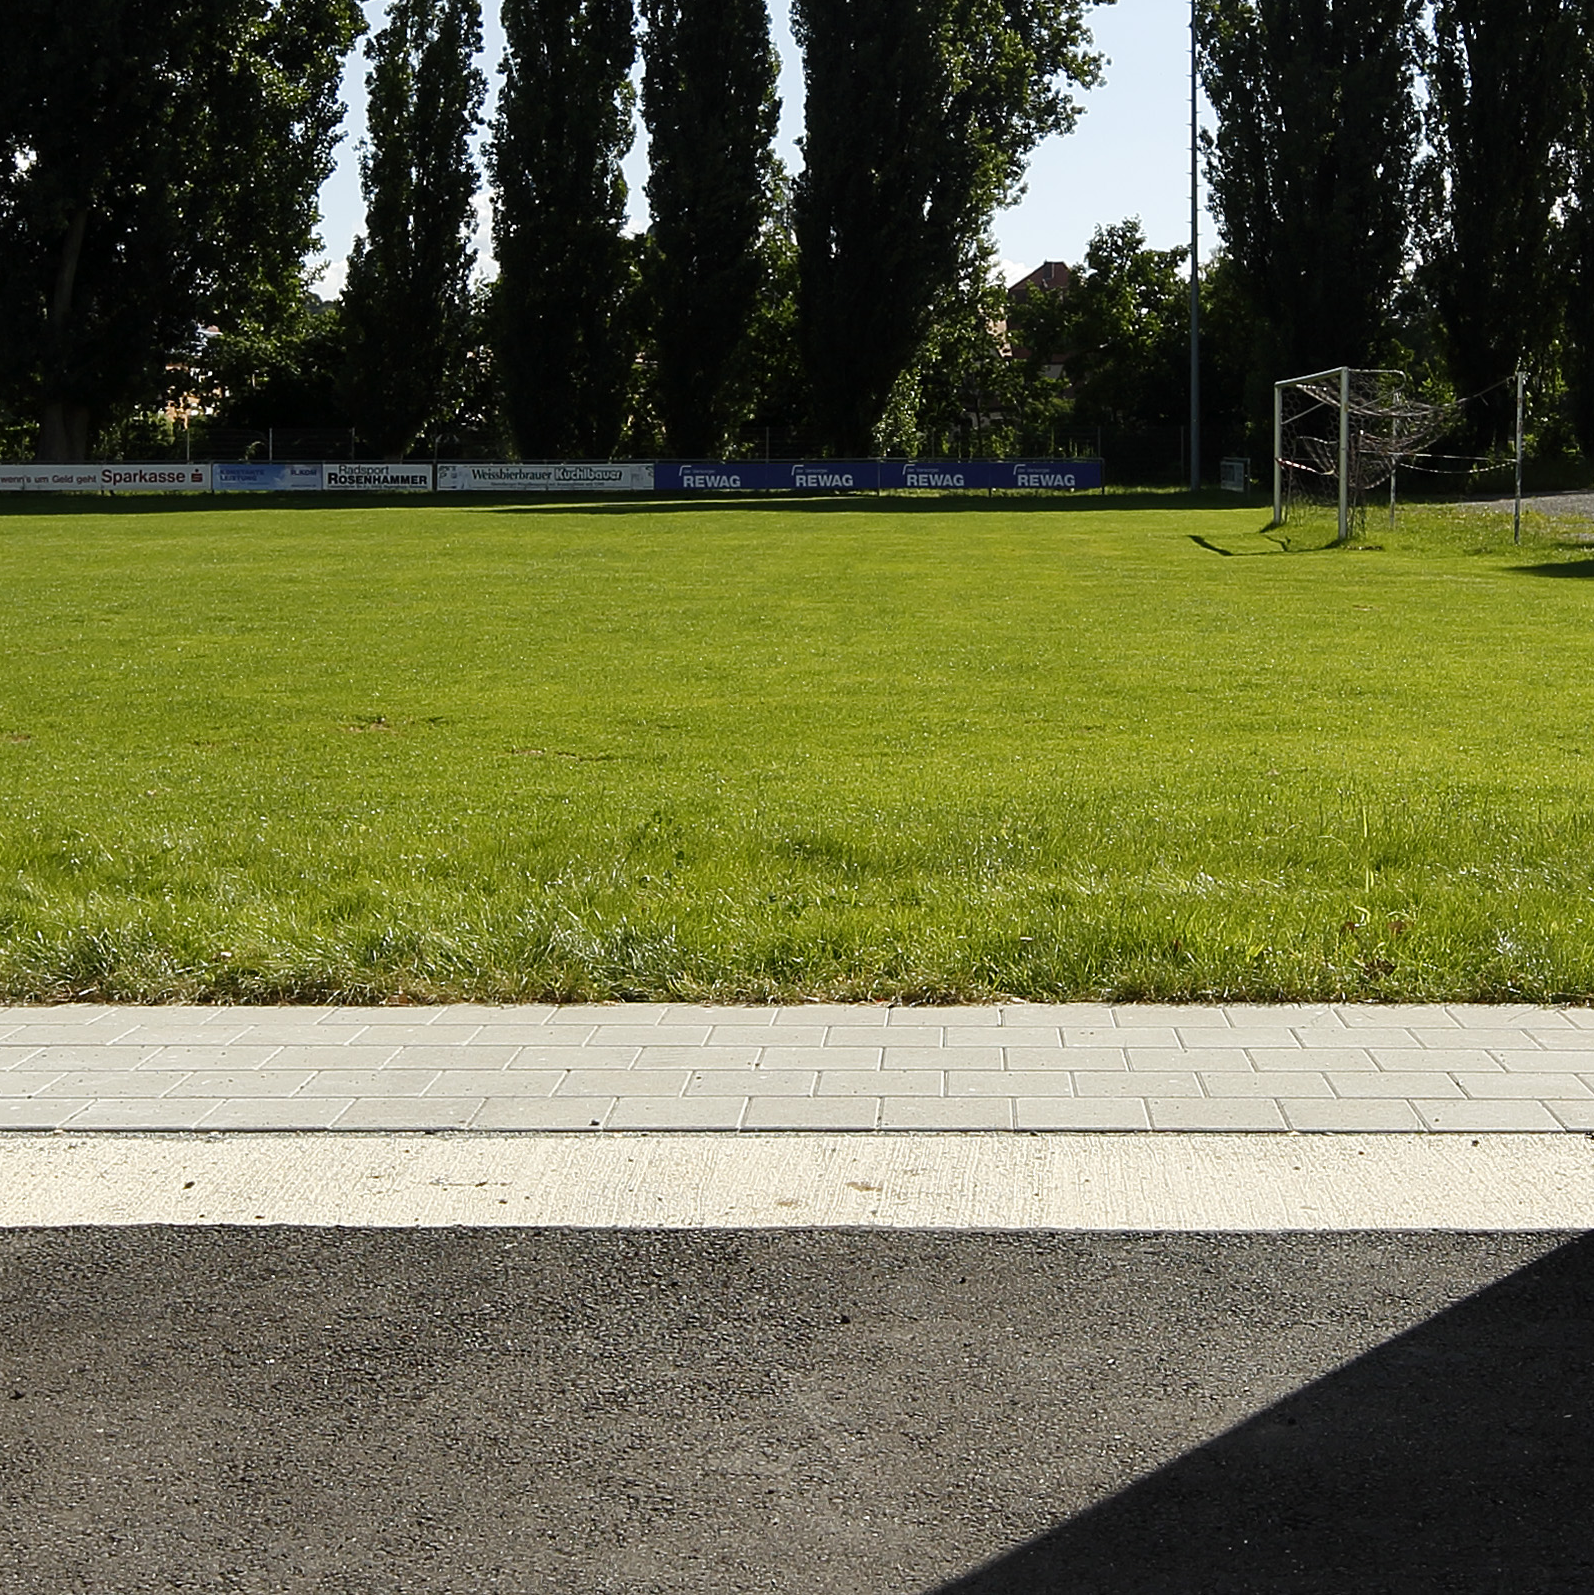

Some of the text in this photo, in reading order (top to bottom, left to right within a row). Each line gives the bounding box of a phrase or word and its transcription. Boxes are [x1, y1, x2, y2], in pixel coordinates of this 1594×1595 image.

[101, 469, 186, 485] Sparkasse
[339, 465, 389, 476] Radsport
[472, 467, 623, 481] Weissbierbrauer Kuchlbauer
[0, 474, 32, 483] wenn's
[52, 474, 73, 483] Geld
[76, 474, 97, 485] geht
[328, 472, 427, 485] ROSENHAMMER
[683, 475, 741, 488] REWAG
[795, 474, 854, 487] REWAG
[906, 474, 965, 487] REWAG
[1017, 474, 1076, 487] REWAG
